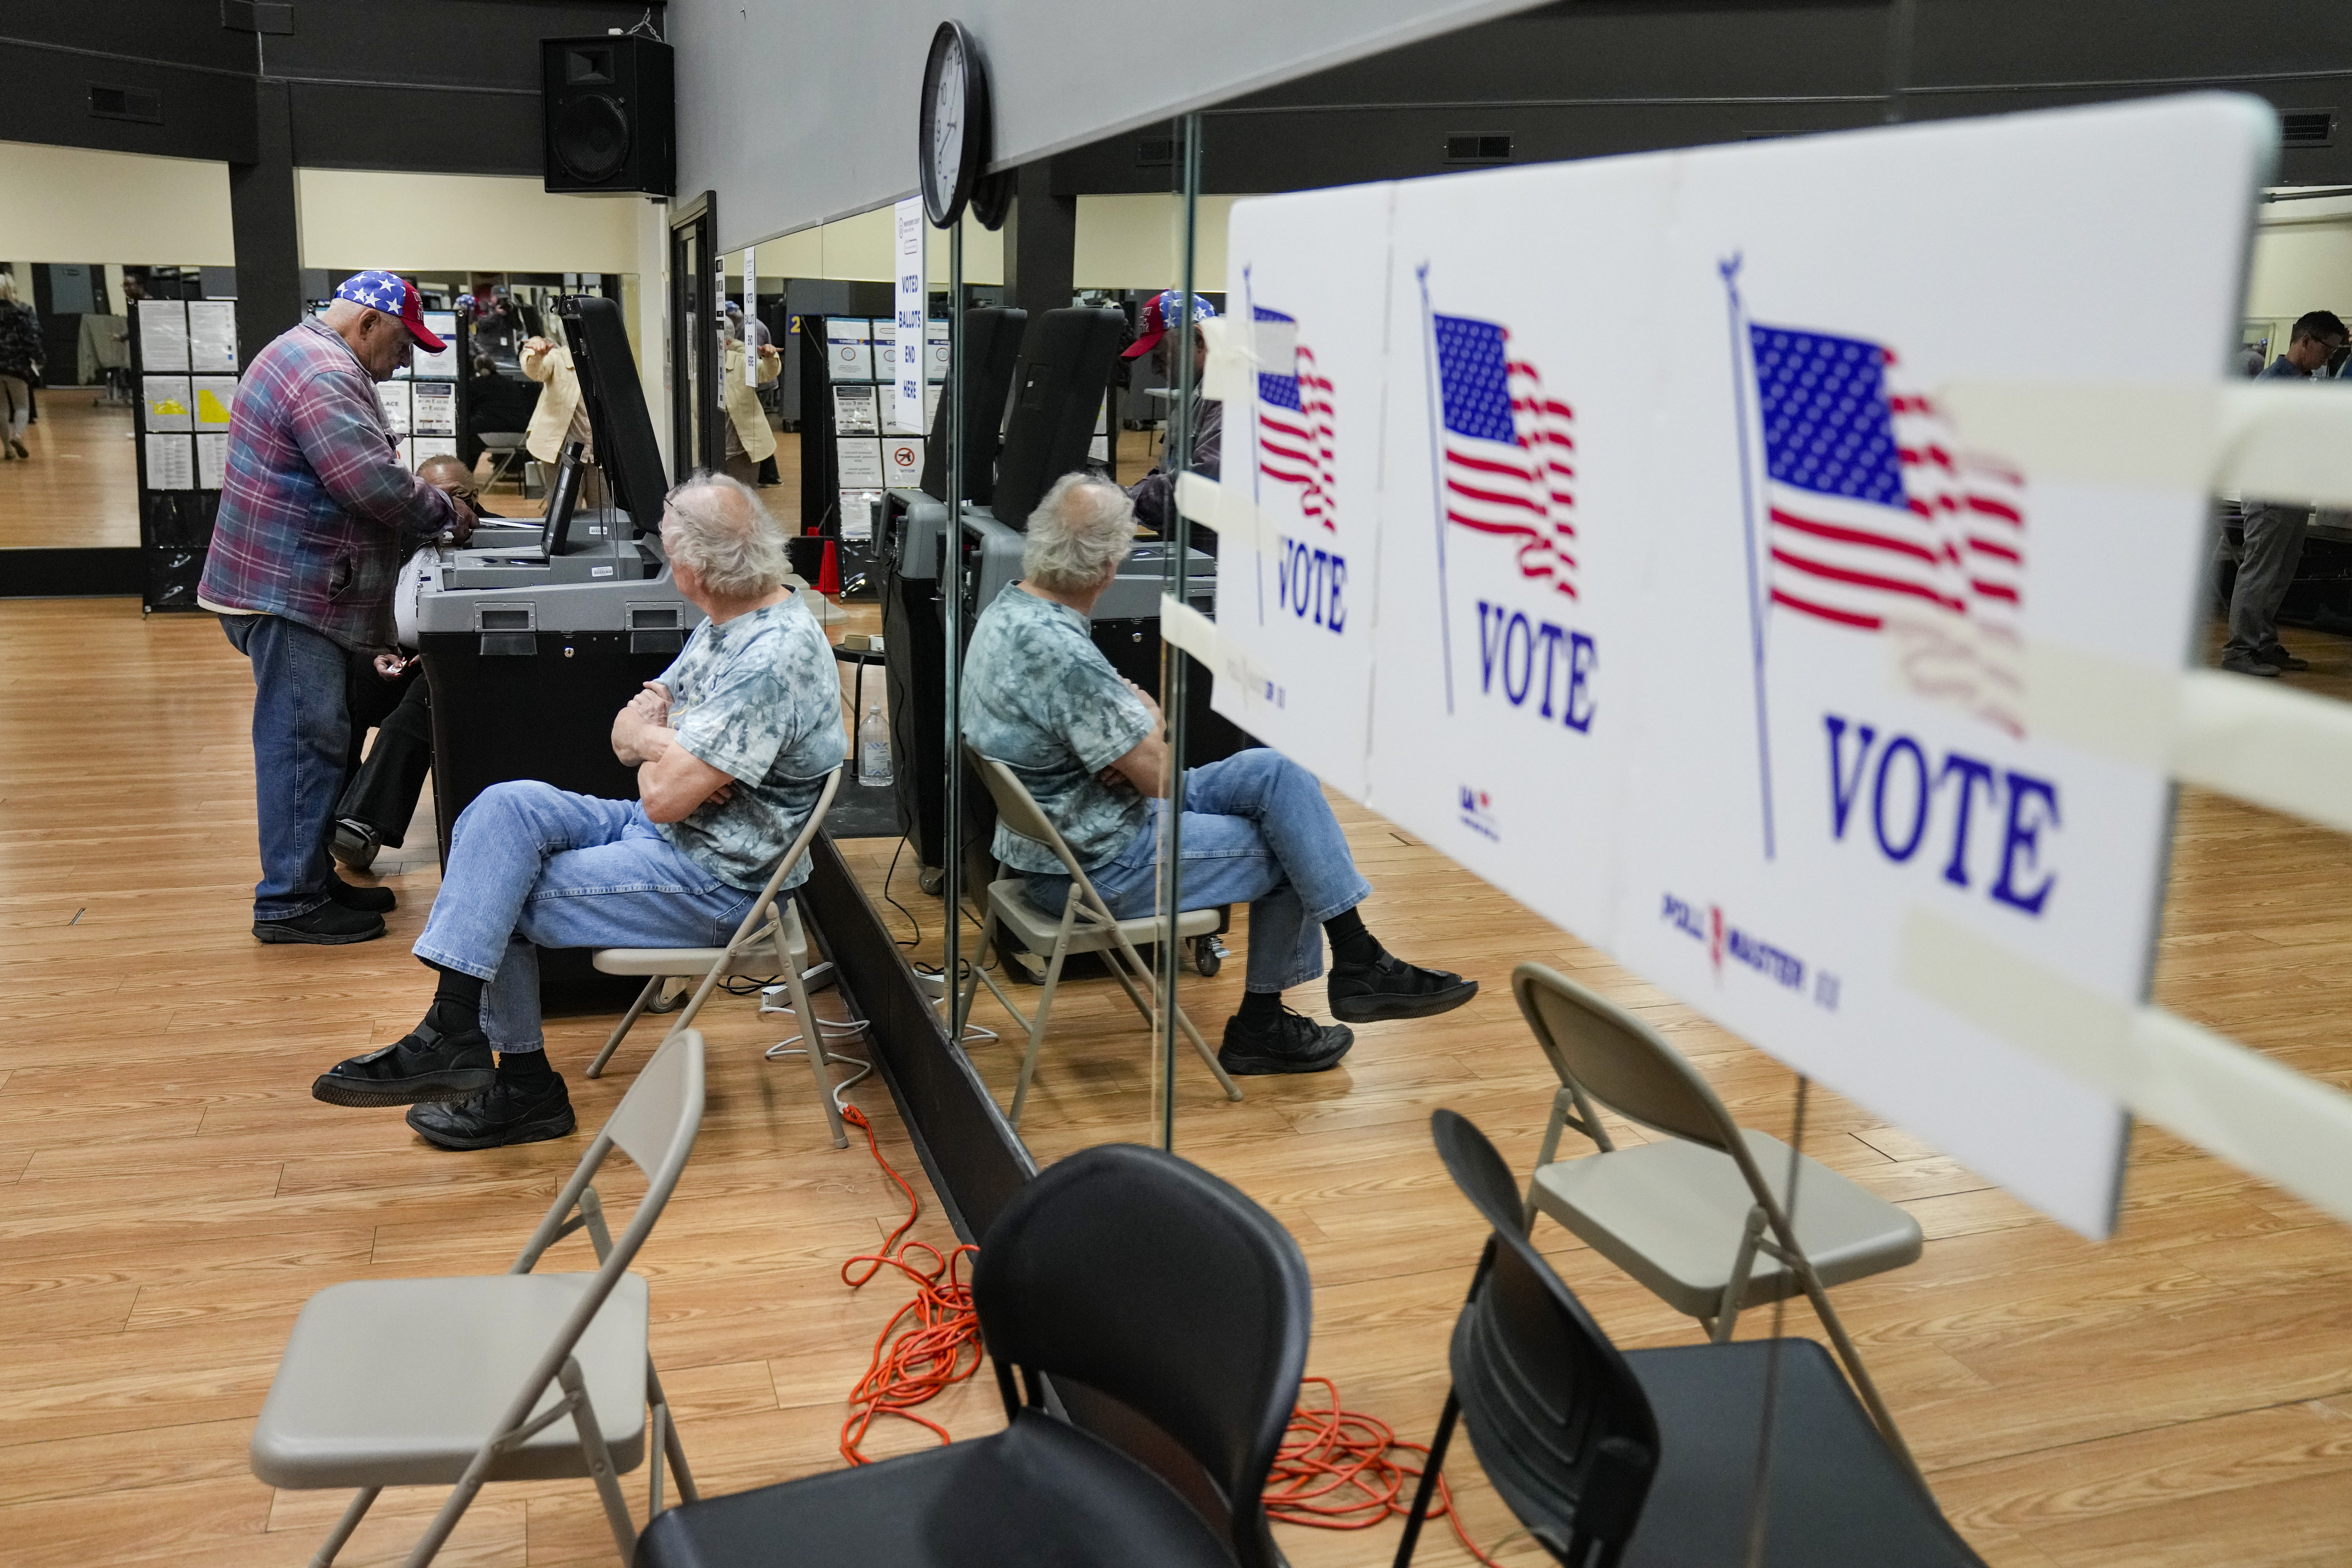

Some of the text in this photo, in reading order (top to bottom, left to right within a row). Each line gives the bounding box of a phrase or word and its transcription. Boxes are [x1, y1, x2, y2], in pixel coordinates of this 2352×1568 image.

[941, 82, 947, 106] 10
[902, 275, 918, 294] VOTED
[791, 316, 800, 333] 2
[899, 310, 921, 328] BALLOTS
[905, 345, 915, 363] END
[904, 380, 916, 399] HERE
[1278, 536, 1346, 633] VOTE
[1477, 600, 1598, 735] VOTE
[1824, 713, 2061, 918] VOTE
